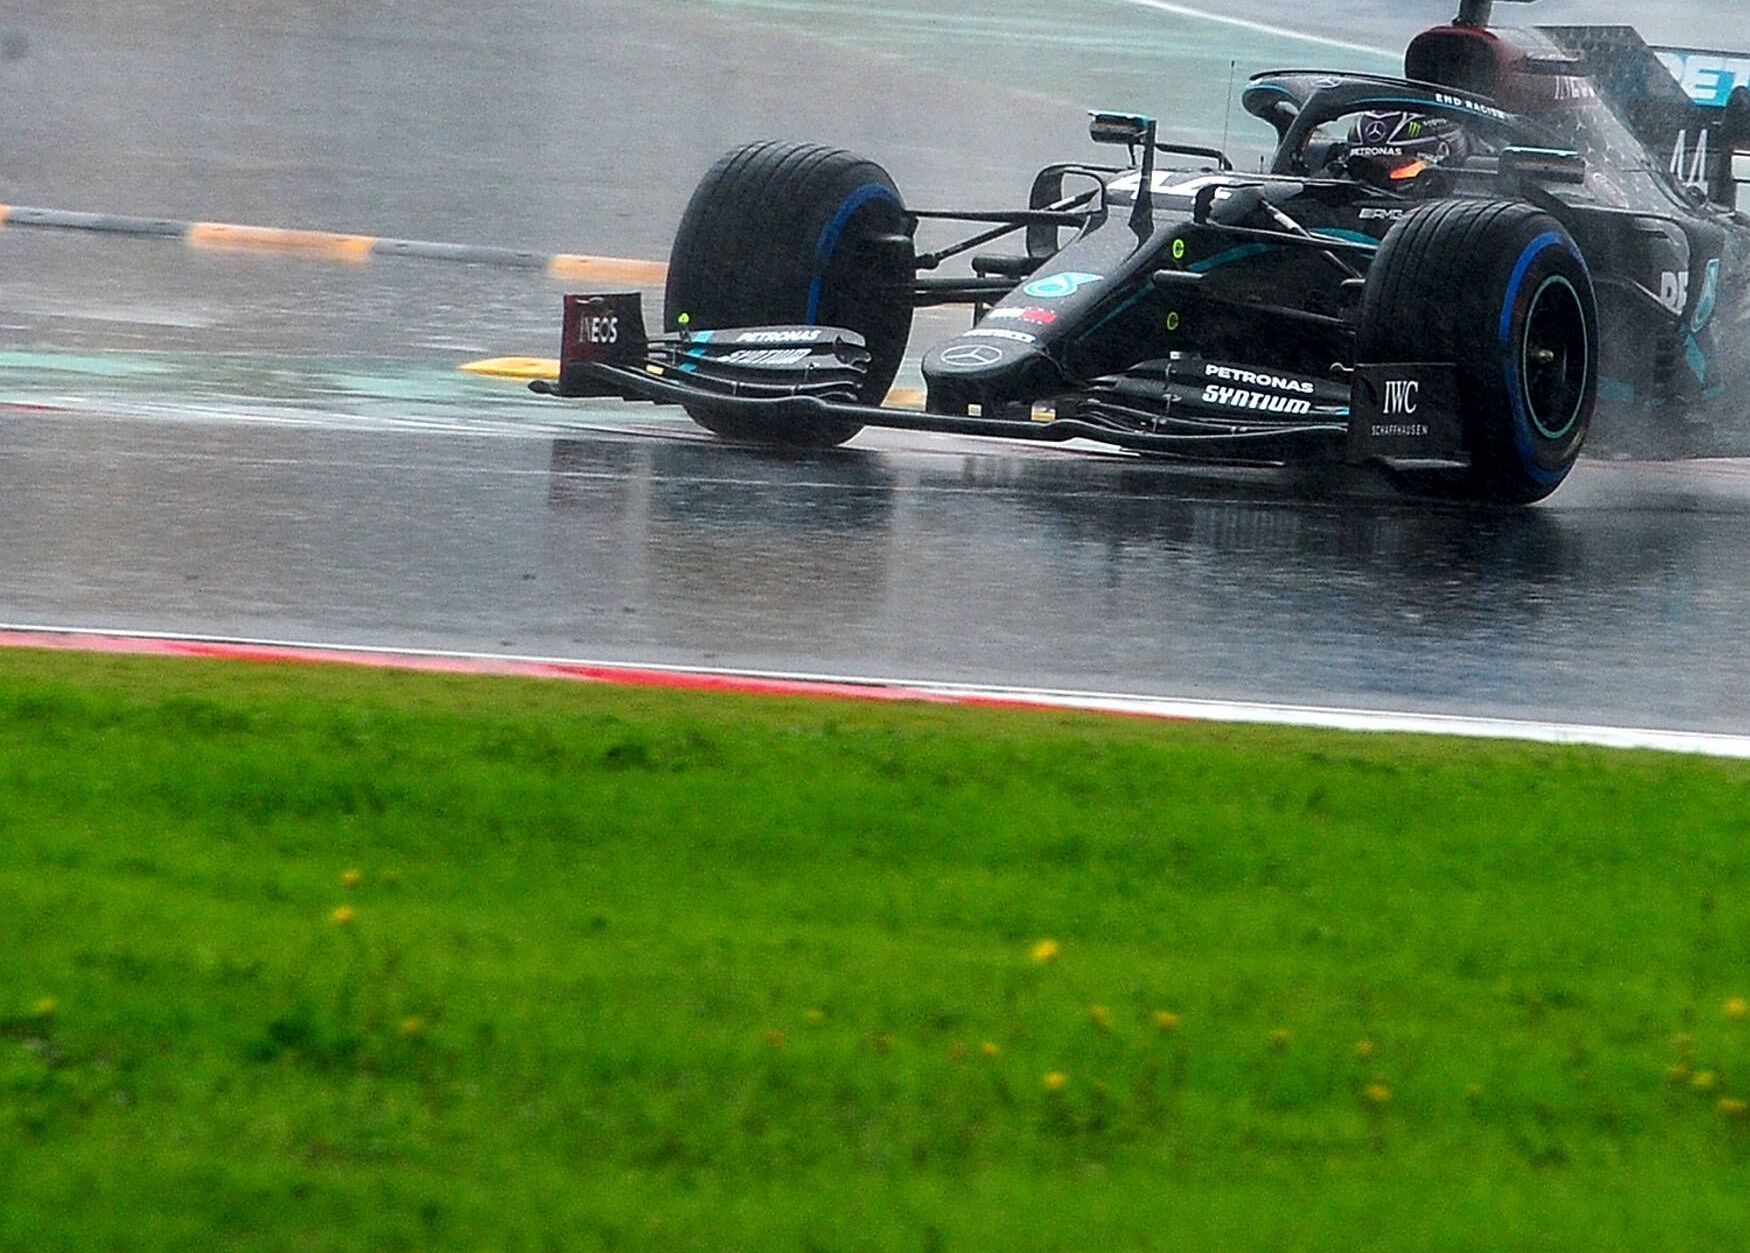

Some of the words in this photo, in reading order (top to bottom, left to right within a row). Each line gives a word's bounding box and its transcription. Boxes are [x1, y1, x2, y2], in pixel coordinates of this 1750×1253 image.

[1435, 93, 1462, 106] END
[579, 316, 619, 344] INEOS
[736, 330, 822, 343] PETRONAS
[1205, 364, 1314, 394] PETRONAS
[1202, 385, 1312, 415] SYNTIUM
[1383, 380, 1419, 415] IWC
[1371, 424, 1429, 437] SCHAFFHAUSEN
